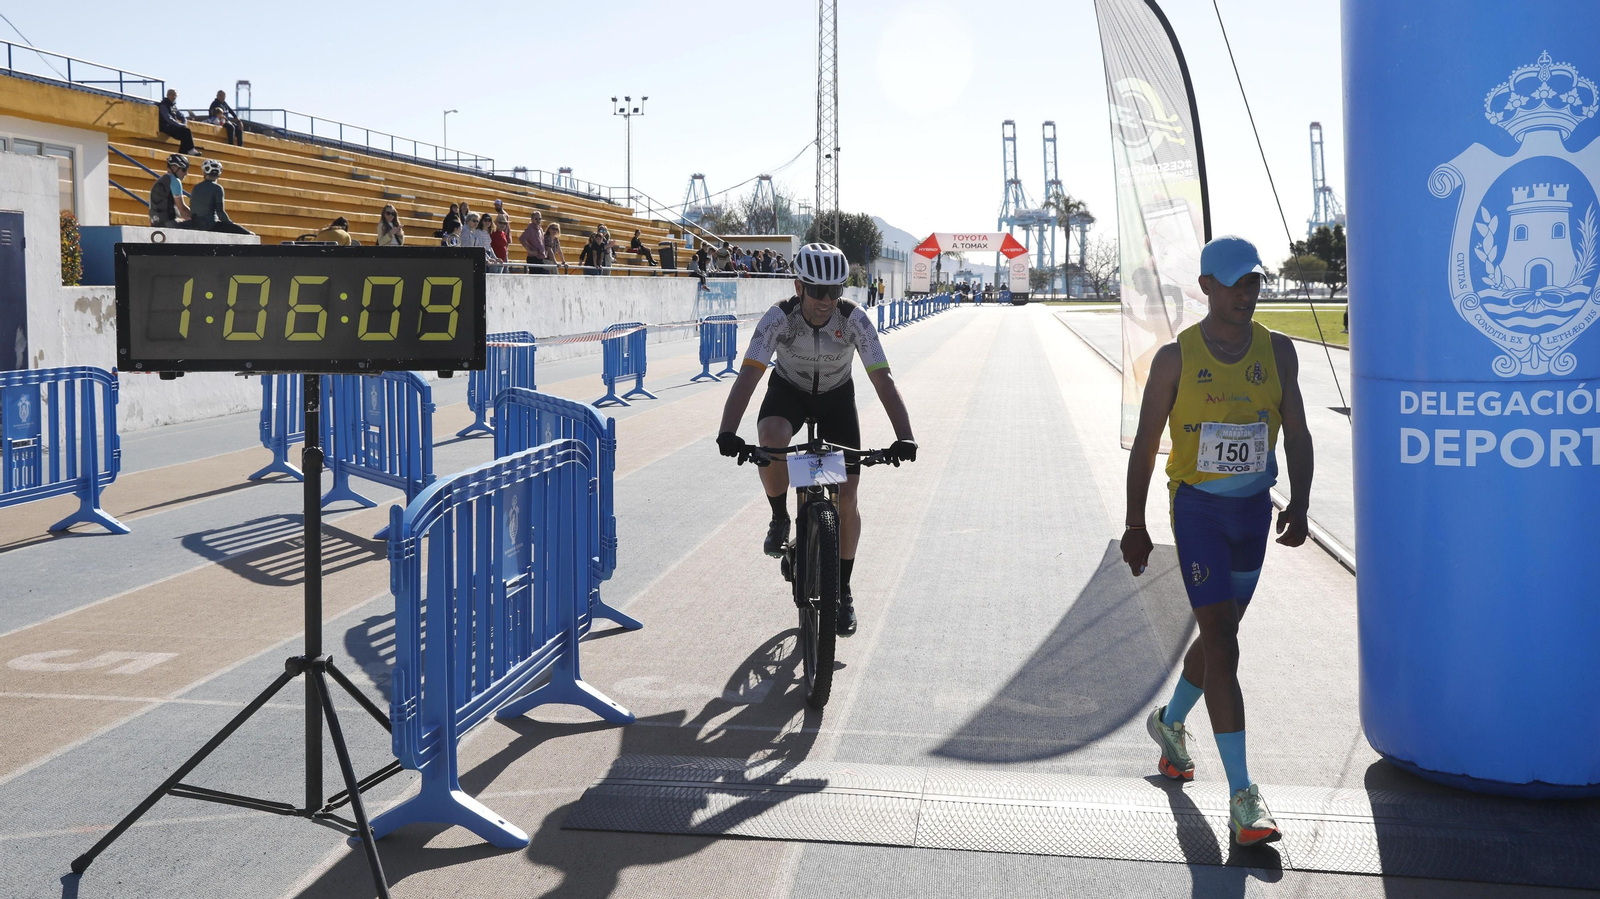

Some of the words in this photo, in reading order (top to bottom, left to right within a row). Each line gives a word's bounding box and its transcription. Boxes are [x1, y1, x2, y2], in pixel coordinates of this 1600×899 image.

[1456, 252, 1468, 290] CIVITAS
[178, 274, 463, 341] 1:06:09
[1474, 314, 1507, 342] CONDITA
[1509, 336, 1523, 344] EX
[1584, 309, 1597, 324] BIS
[786, 350, 823, 362] Special
[1400, 382, 1600, 416] DELEGACIÓ
[1214, 442, 1249, 462] 150
